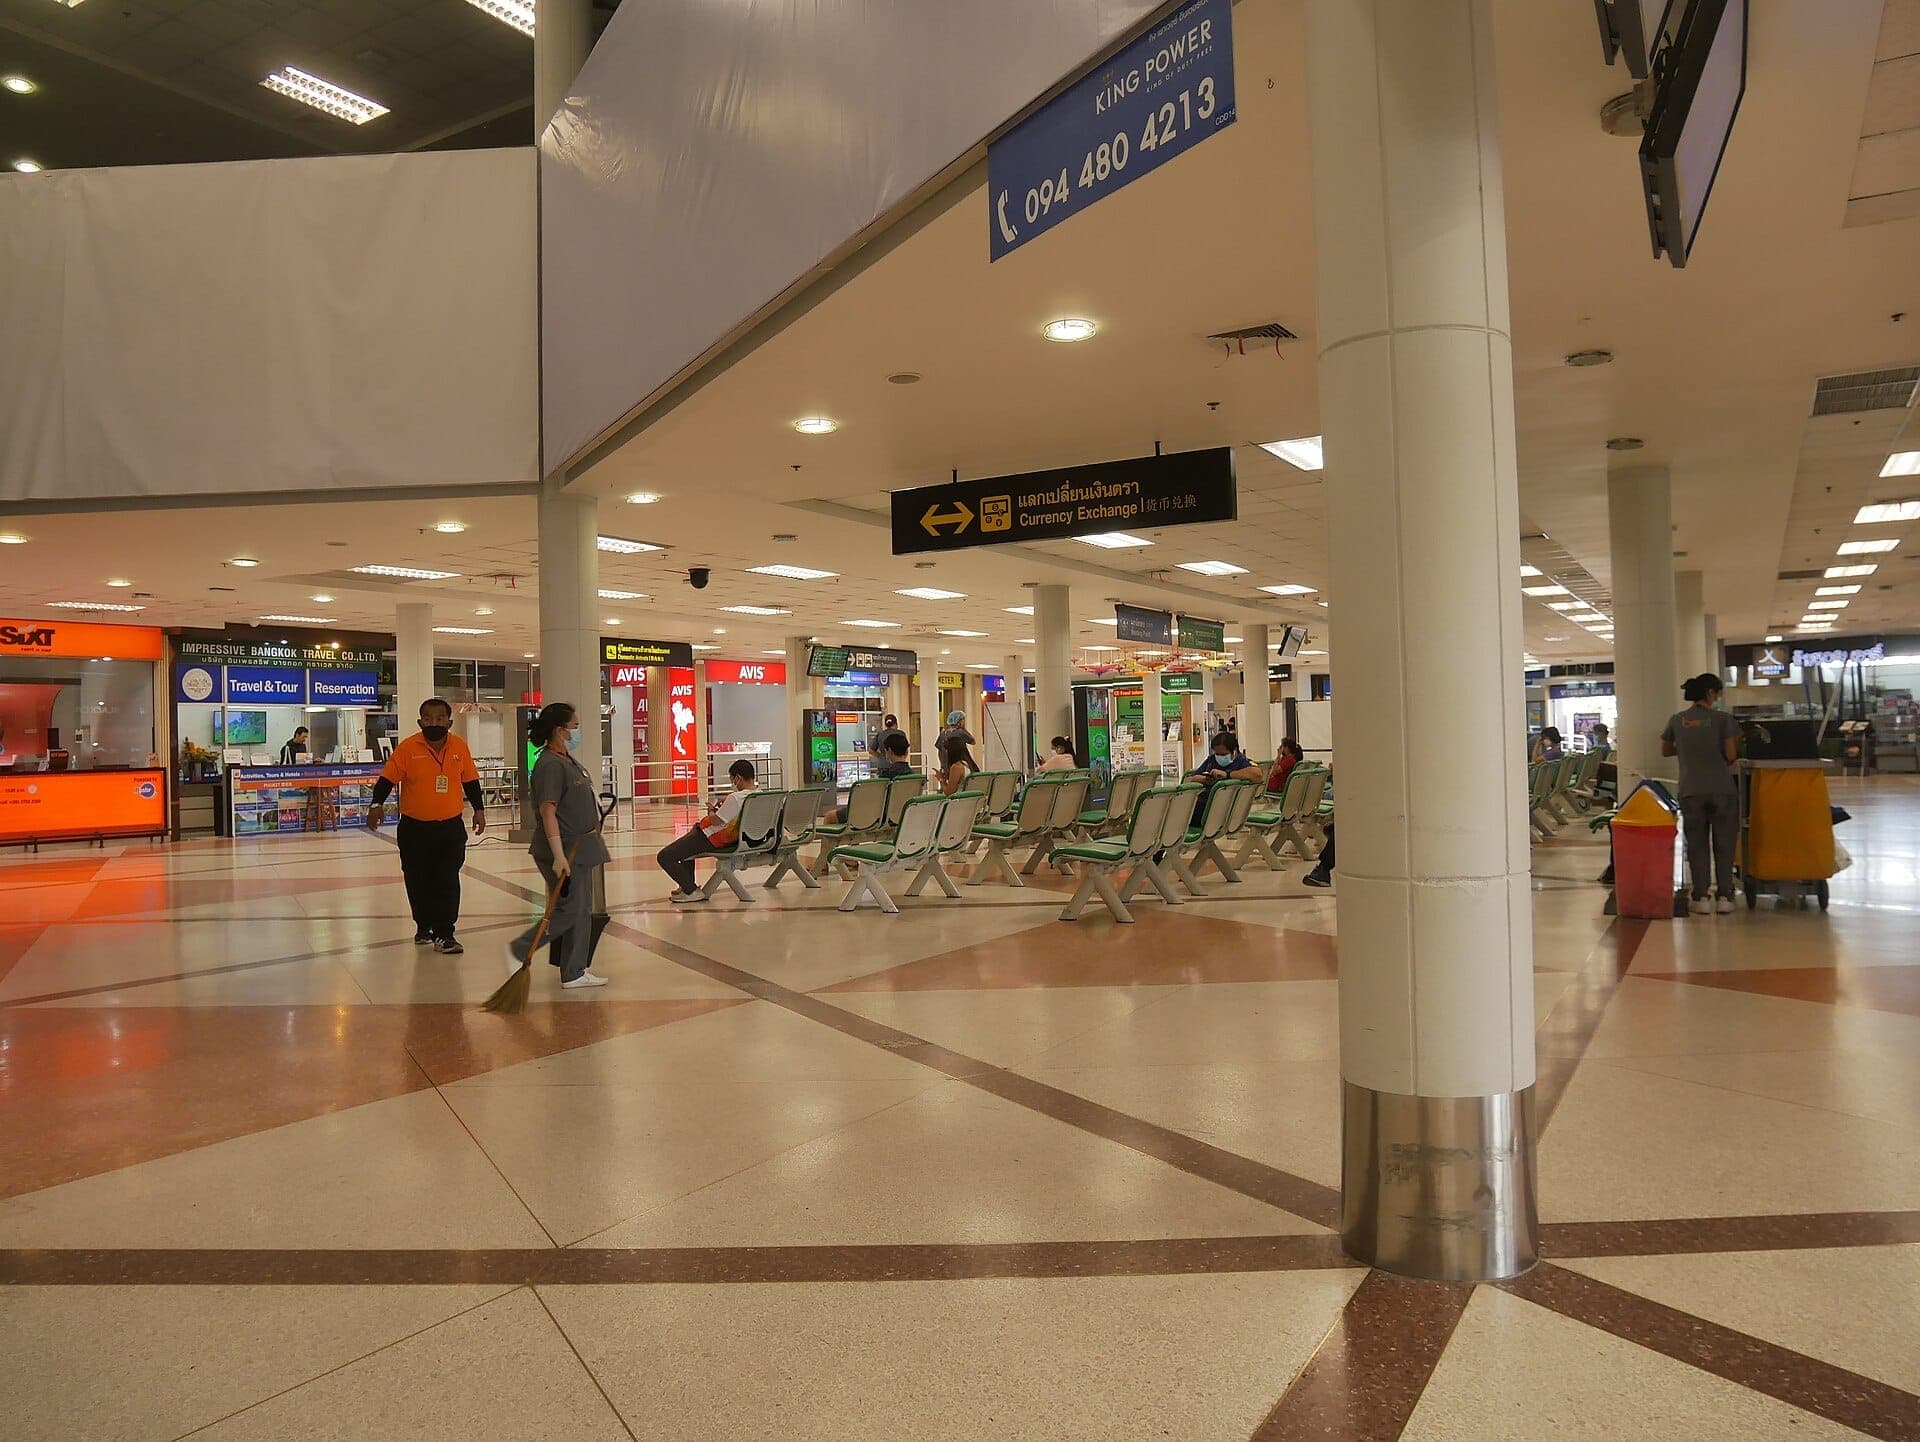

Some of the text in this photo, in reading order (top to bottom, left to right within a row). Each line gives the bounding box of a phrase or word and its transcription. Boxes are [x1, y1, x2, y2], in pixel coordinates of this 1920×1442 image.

[1095, 69, 1140, 115] KING
[1145, 18, 1212, 82] POWER
[1025, 76, 1216, 224] 094 480 4213
[1018, 480, 1140, 508] แลกเปลี่ยนเงินตรา
[1019, 502, 1137, 527] Currency Exchange
[182, 642, 246, 655] IMPRESSIVE
[251, 646, 297, 658] BANGKOK
[302, 649, 337, 660] TRAVEL
[615, 667, 646, 682] AVIS
[739, 665, 764, 680] AVIS
[229, 679, 299, 693] Travel & Tour
[314, 682, 375, 695] Reservation
[671, 685, 693, 696] AVIS
